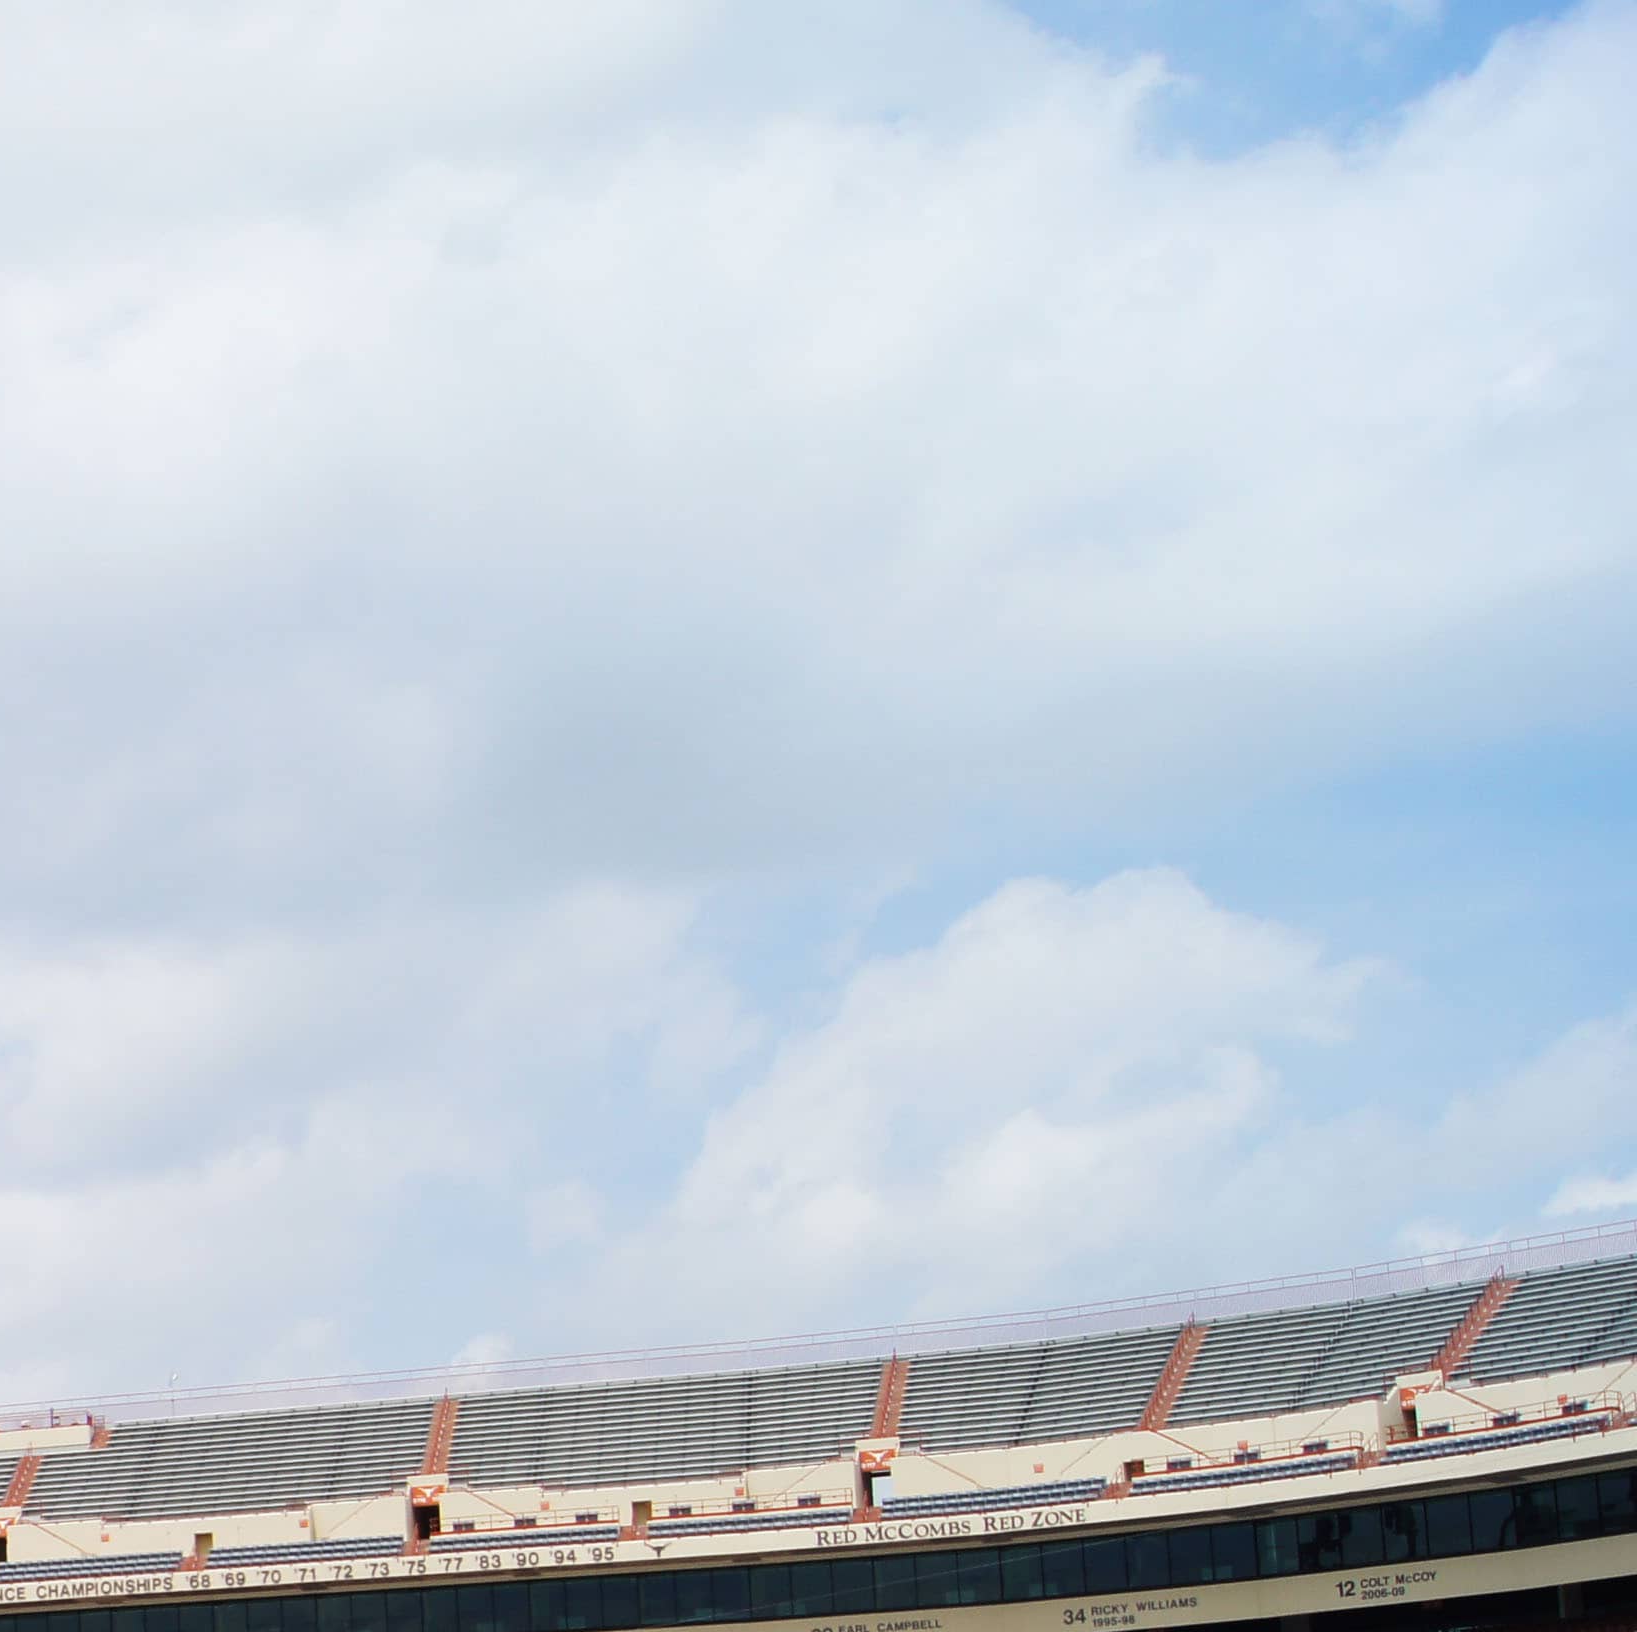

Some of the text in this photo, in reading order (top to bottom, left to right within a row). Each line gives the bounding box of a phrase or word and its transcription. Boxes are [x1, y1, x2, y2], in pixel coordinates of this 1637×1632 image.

[36, 1577, 173, 1598] CHAMPIONSHIPS
[1335, 1571, 1437, 1598] 12 COLT McCOY
[1361, 1586, 1405, 1600] 2006-09
[1063, 1597, 1197, 1625] 34 RICKY WILLIAMS
[877, 1619, 942, 1632] CAMPBELL
